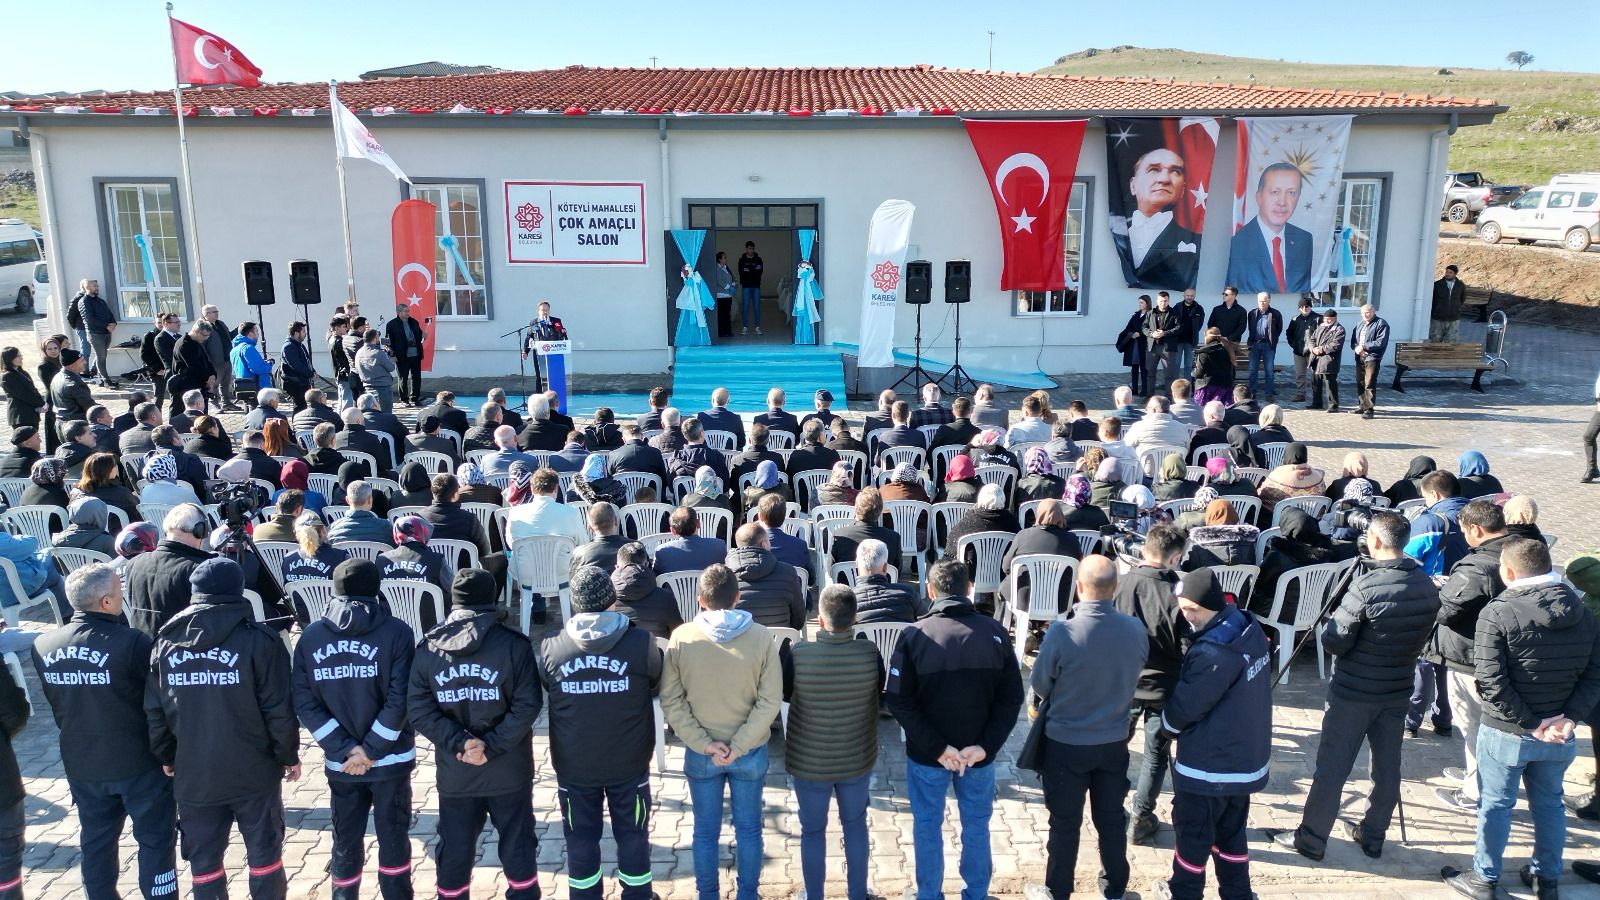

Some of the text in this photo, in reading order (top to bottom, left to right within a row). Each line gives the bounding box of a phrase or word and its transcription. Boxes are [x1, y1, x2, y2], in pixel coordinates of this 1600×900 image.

[557, 202, 636, 213] KÖTEYLİ MAHALLESİ
[558, 217, 636, 232] ÇOK AMAÇLI
[577, 233, 619, 246] SALON
[289, 558, 331, 574] KARESİ
[383, 560, 428, 575] KARESİ
[42, 645, 110, 668] KARESİ
[312, 639, 379, 664] KARESİ
[313, 661, 379, 681] BELEDİYESİ
[434, 663, 499, 687] KARESİ
[560, 655, 628, 678] KARESİ
[43, 669, 111, 685] BELEDİYESİ
[167, 669, 240, 686] BELEDİYESİ
[561, 676, 629, 694] BELEDİYESİ
